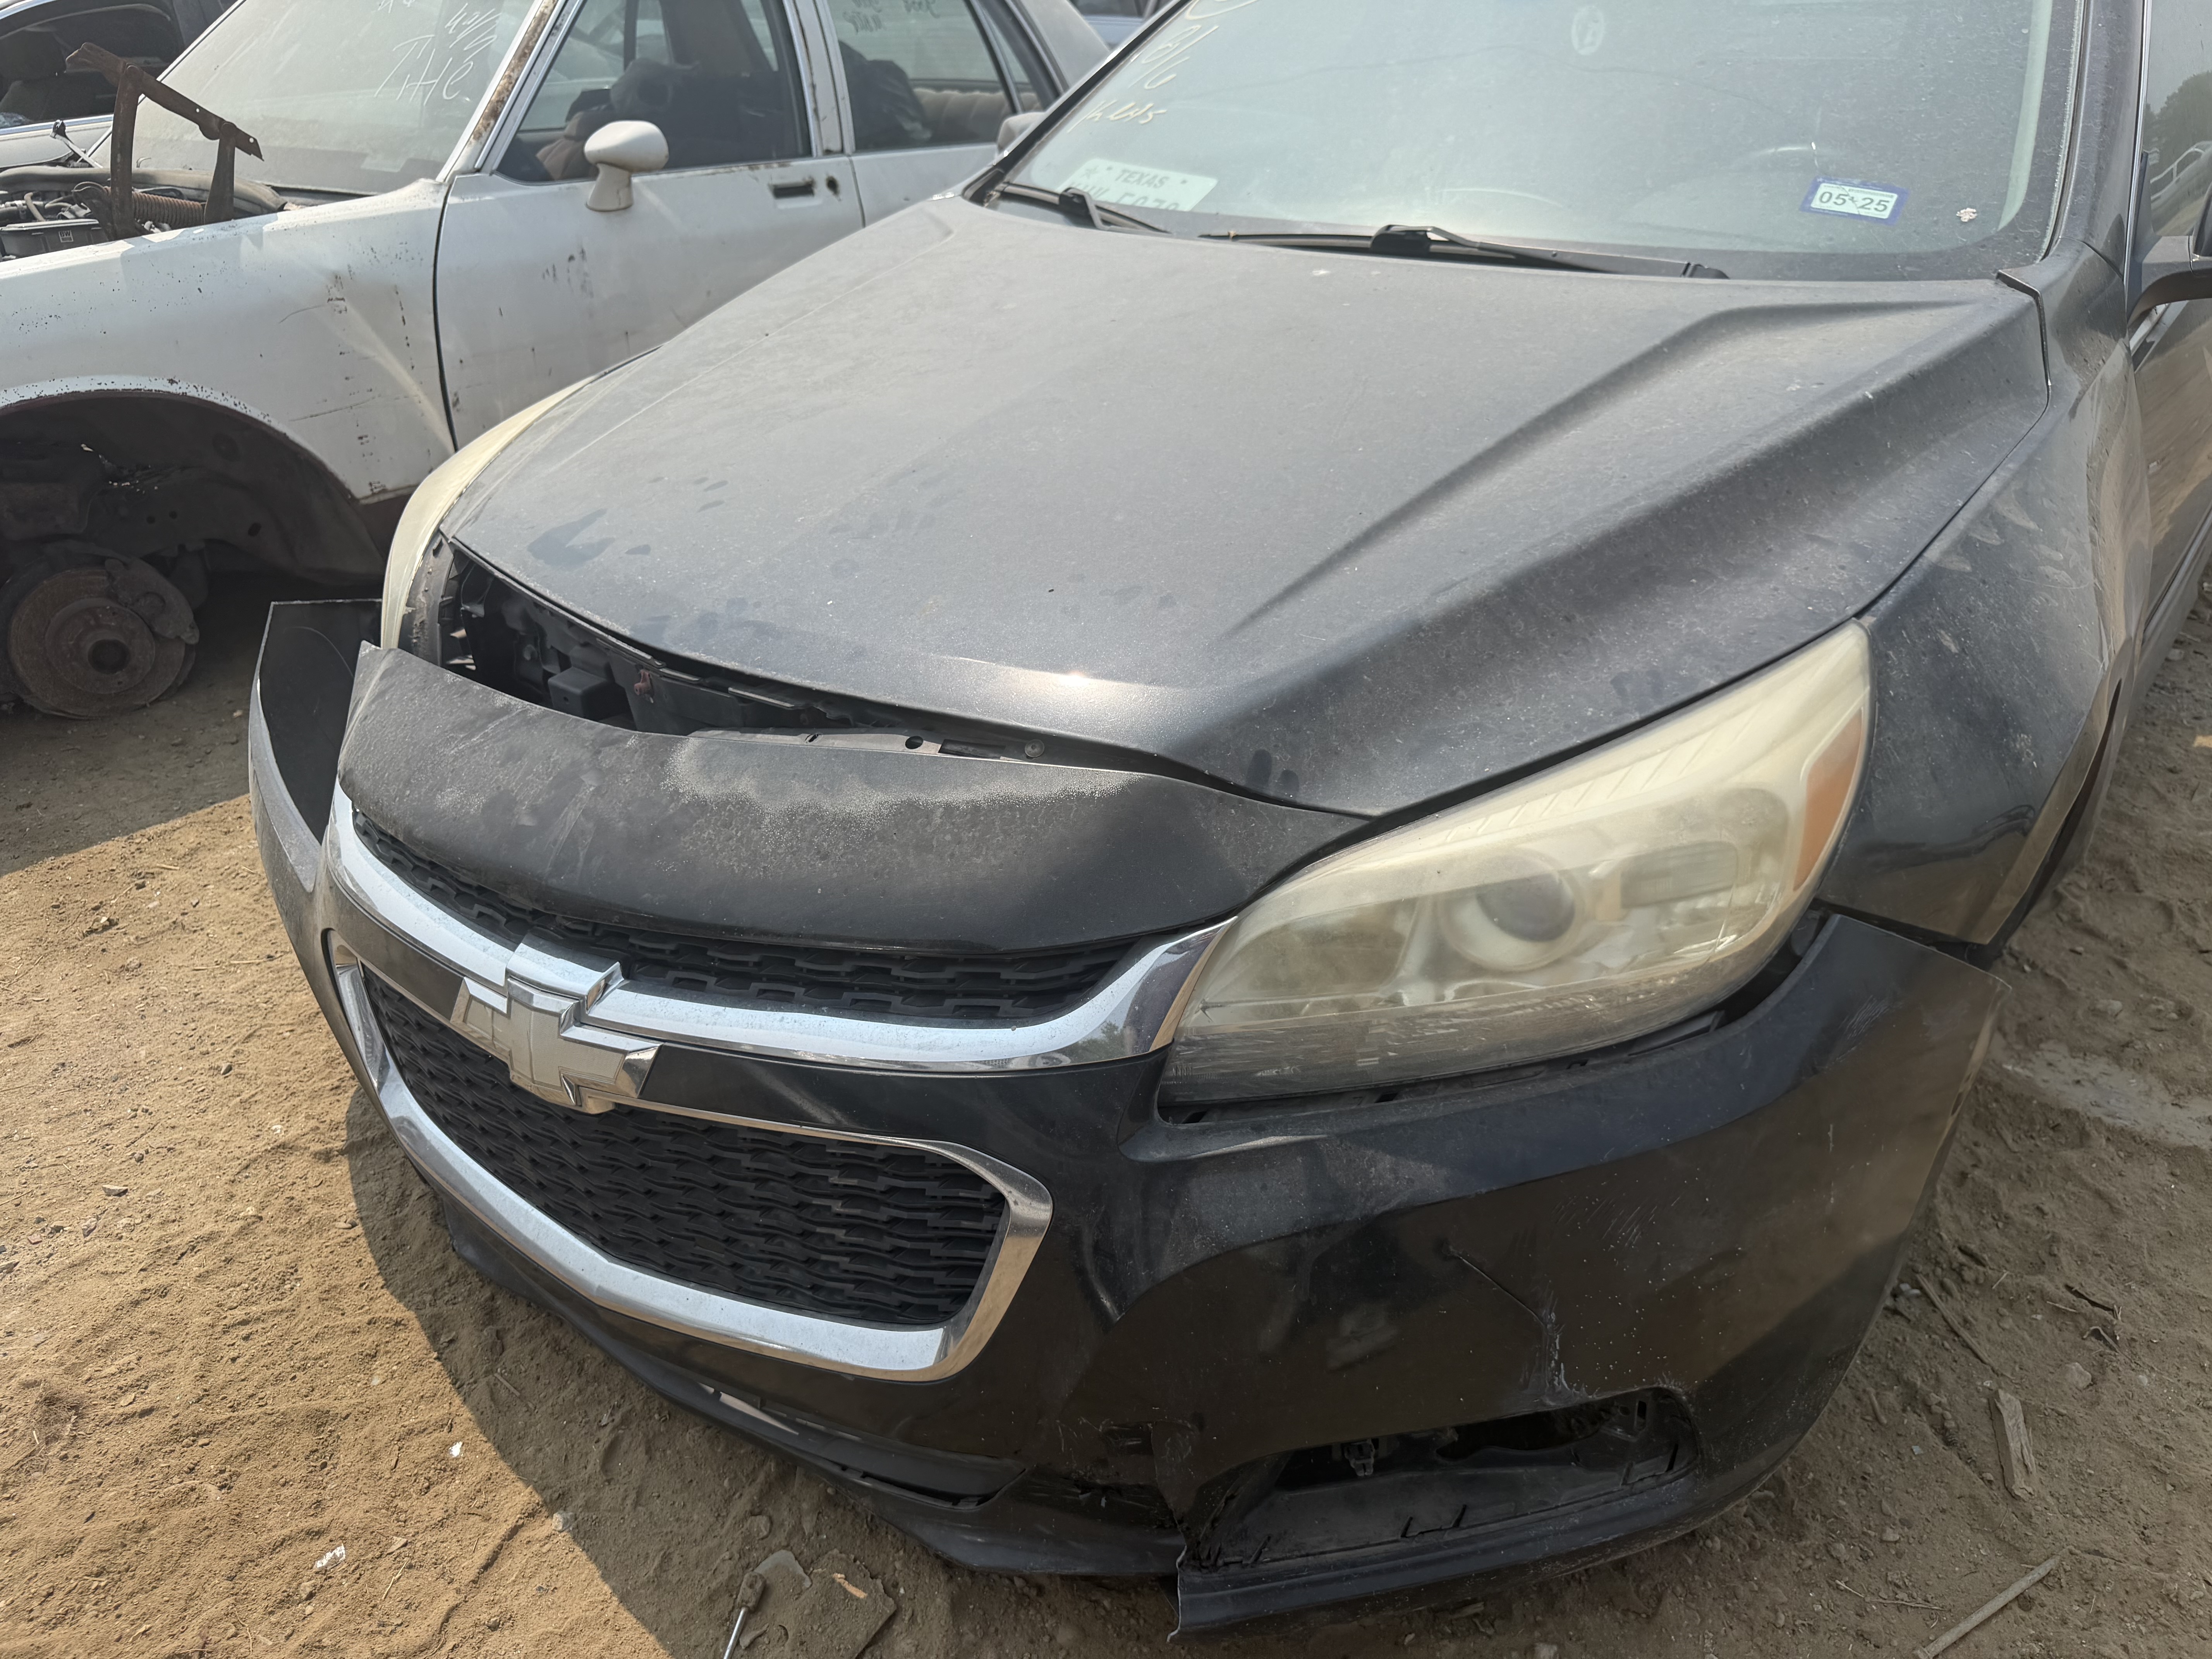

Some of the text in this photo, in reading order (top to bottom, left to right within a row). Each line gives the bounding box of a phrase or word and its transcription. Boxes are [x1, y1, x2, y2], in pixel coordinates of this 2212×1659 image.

[1115, 168, 1170, 189] TEXAS
[1819, 191, 1849, 206] 05
[1858, 197, 1890, 212] 25
